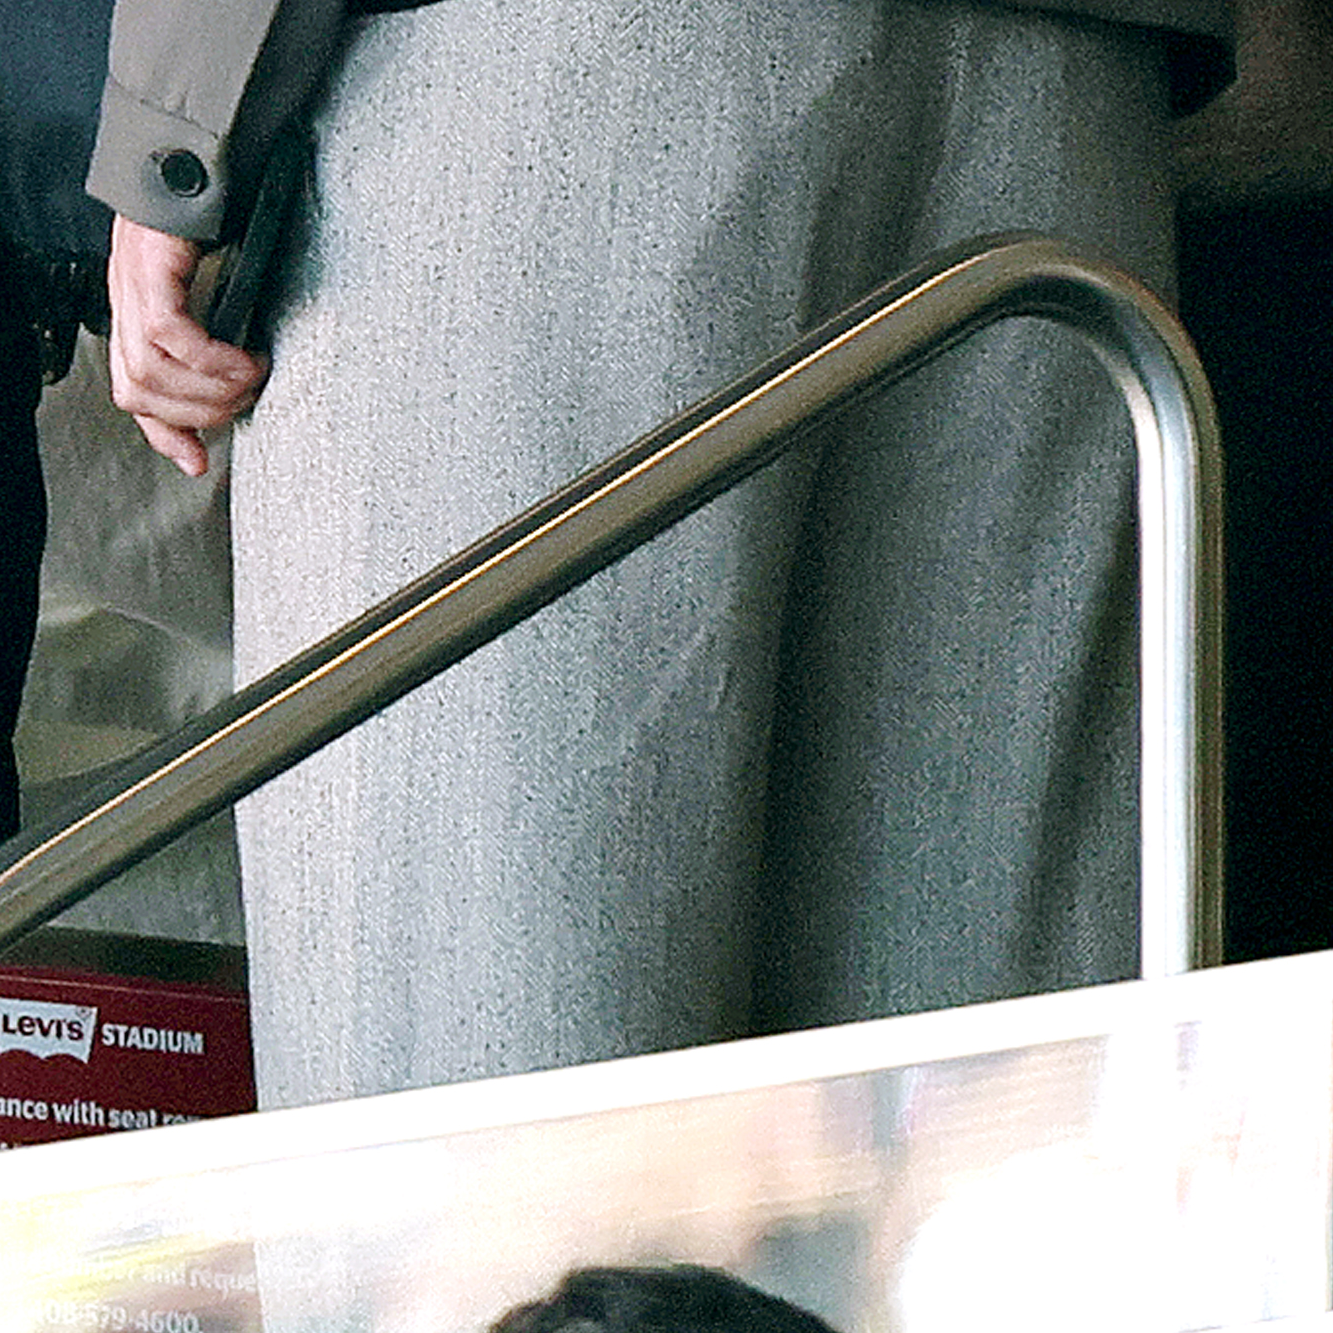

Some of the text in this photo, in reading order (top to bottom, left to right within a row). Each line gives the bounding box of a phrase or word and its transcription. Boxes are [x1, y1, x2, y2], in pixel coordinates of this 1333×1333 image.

[101, 1023, 205, 1054] STADIUM
[52, 1098, 105, 1127] with
[108, 1107, 157, 1130] seat
[190, 1267, 257, 1301] reque
